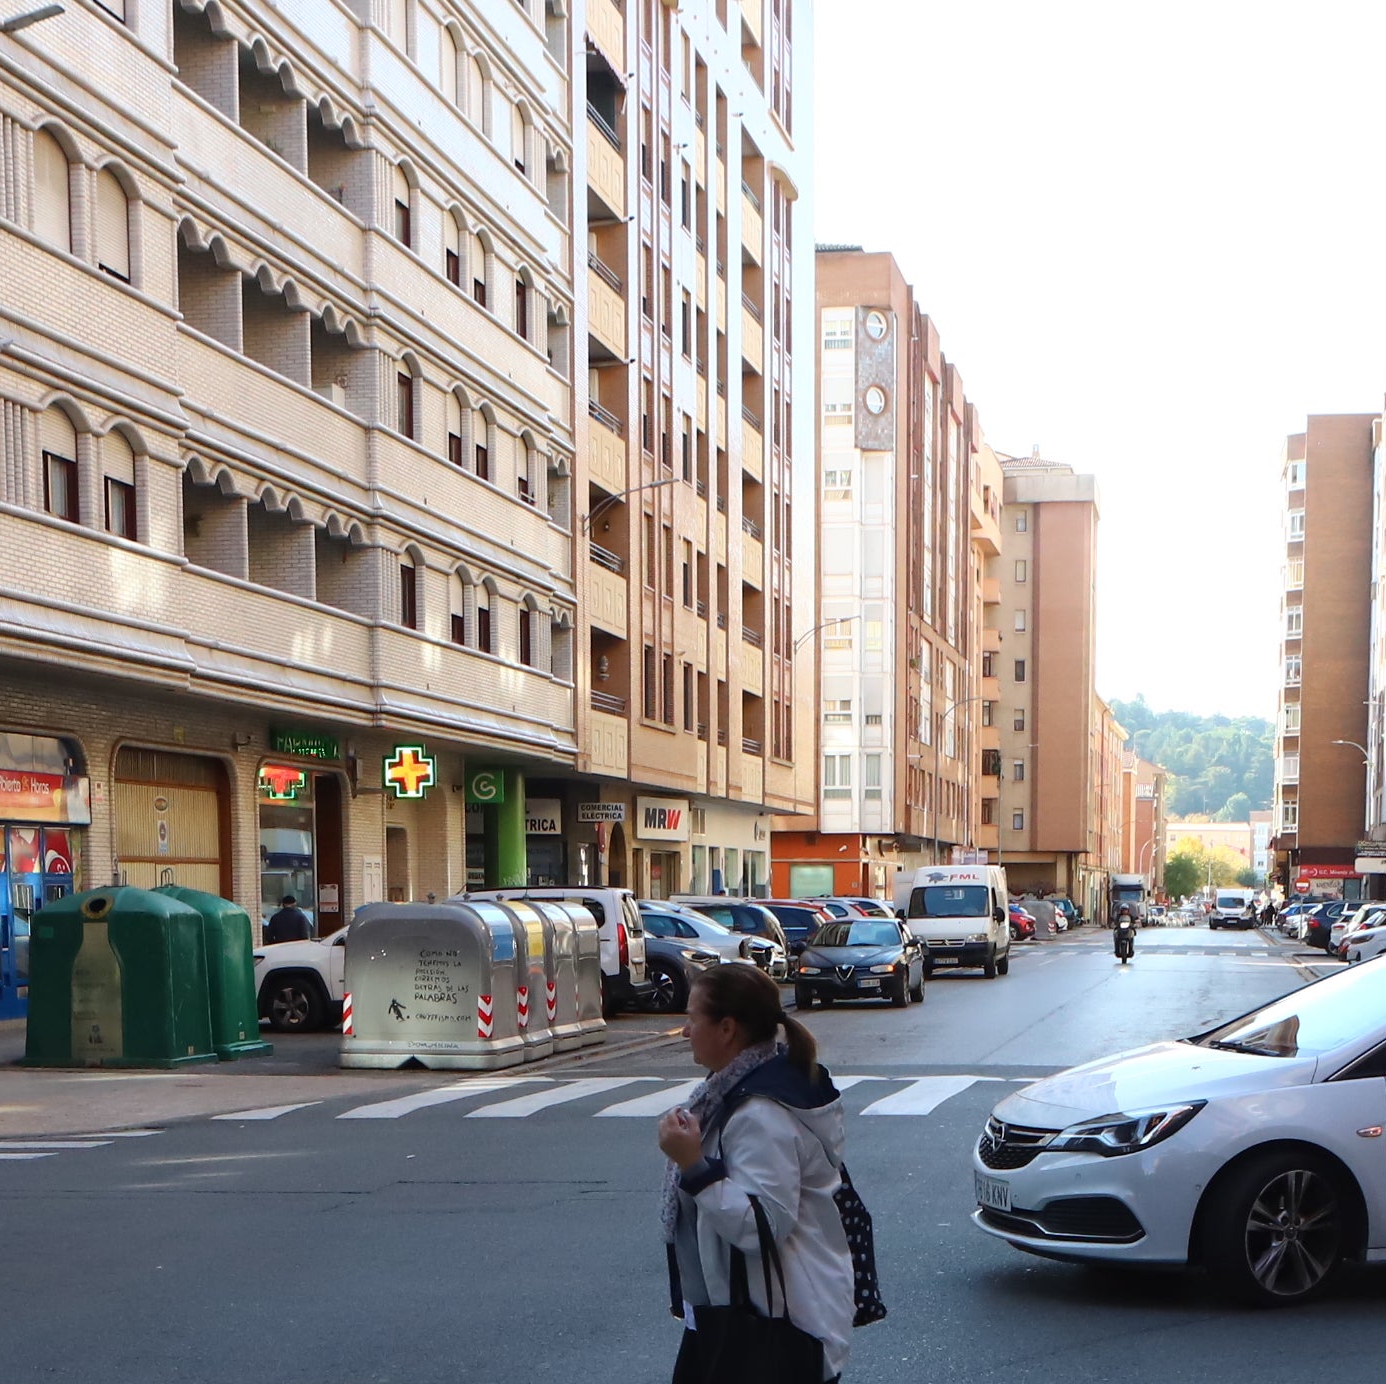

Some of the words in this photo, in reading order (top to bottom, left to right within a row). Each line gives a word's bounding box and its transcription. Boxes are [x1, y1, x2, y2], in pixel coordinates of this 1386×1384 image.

[30, 778, 49, 795] Horas
[580, 804, 623, 812] COMERCIAL
[644, 807, 682, 831] MRW
[949, 874, 980, 882] FML
[419, 949, 442, 958] COMO
[418, 959, 449, 967] TENEMOS
[414, 992, 458, 1004] PALABRAS
